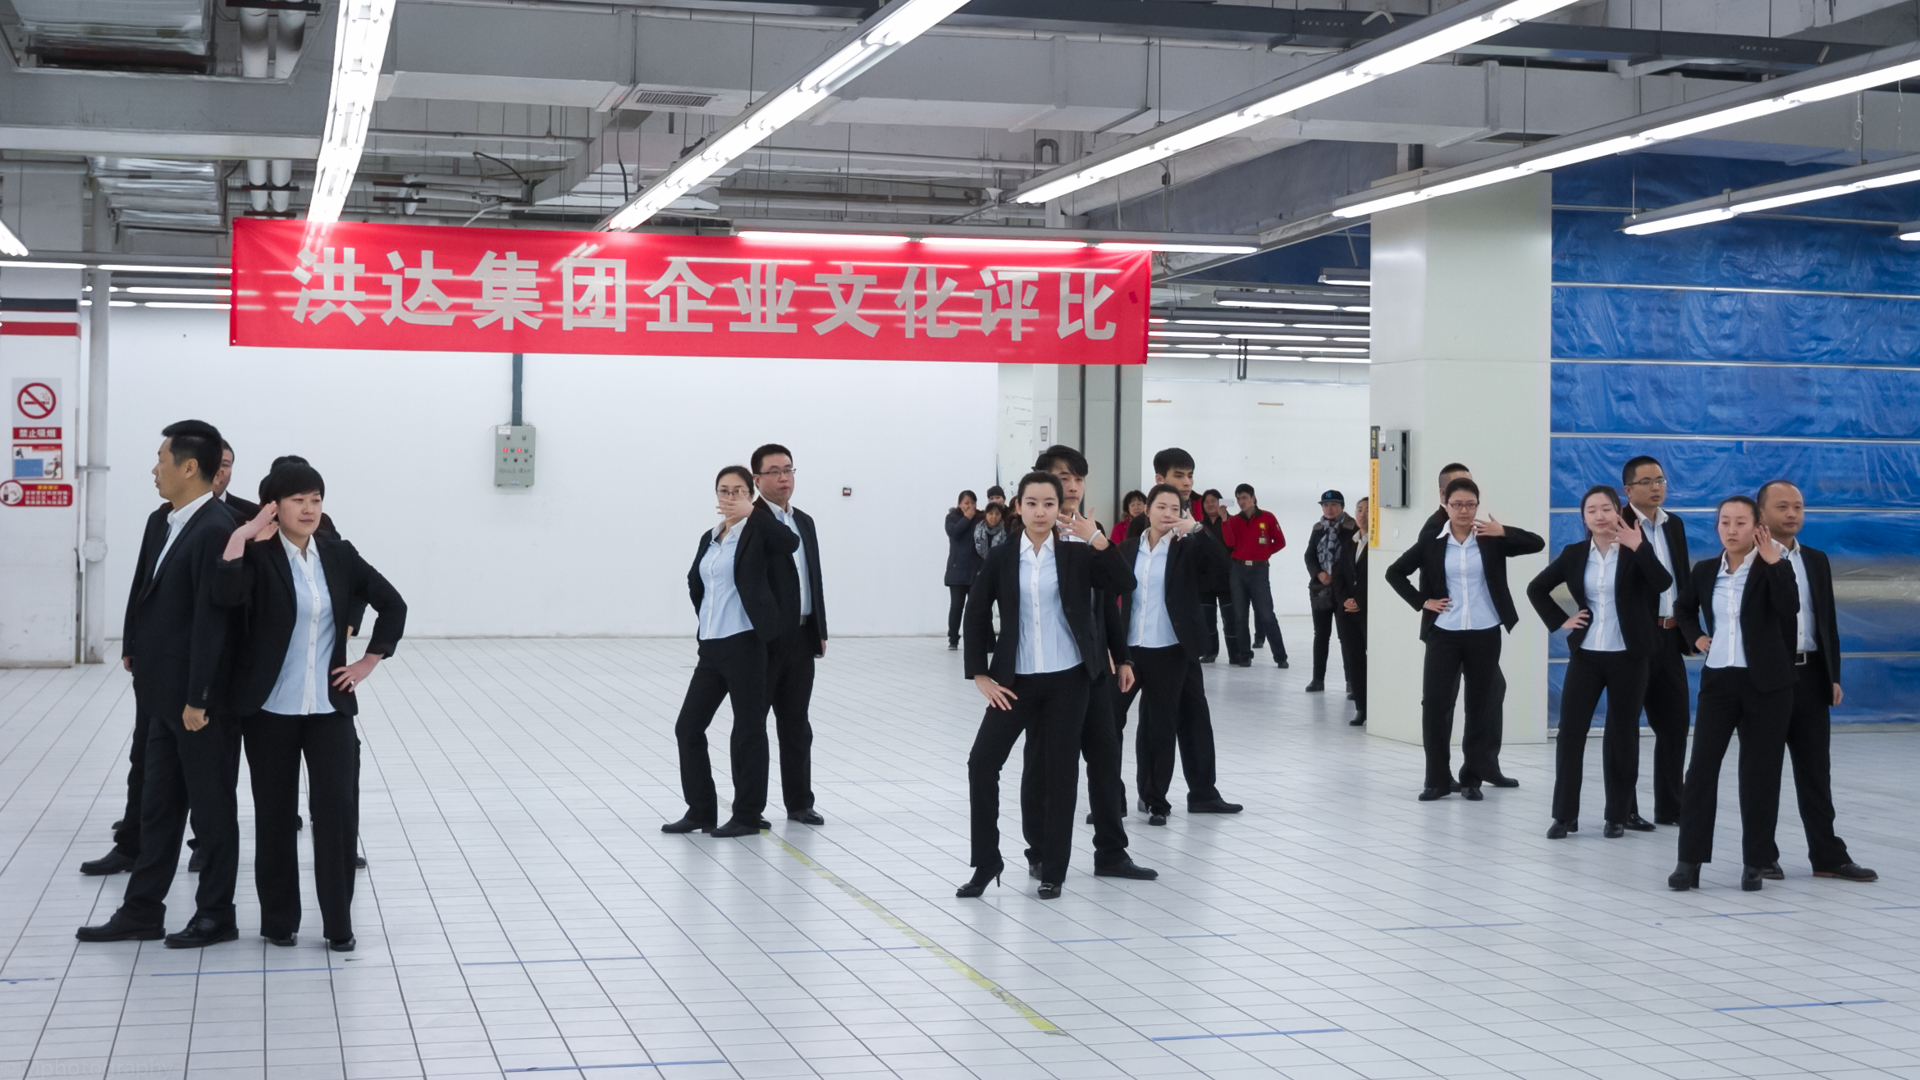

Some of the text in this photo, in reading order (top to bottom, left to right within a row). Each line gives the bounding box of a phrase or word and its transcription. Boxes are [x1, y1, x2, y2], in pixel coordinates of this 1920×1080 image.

[291, 246, 1117, 342] 洪达集团企业文化评比
